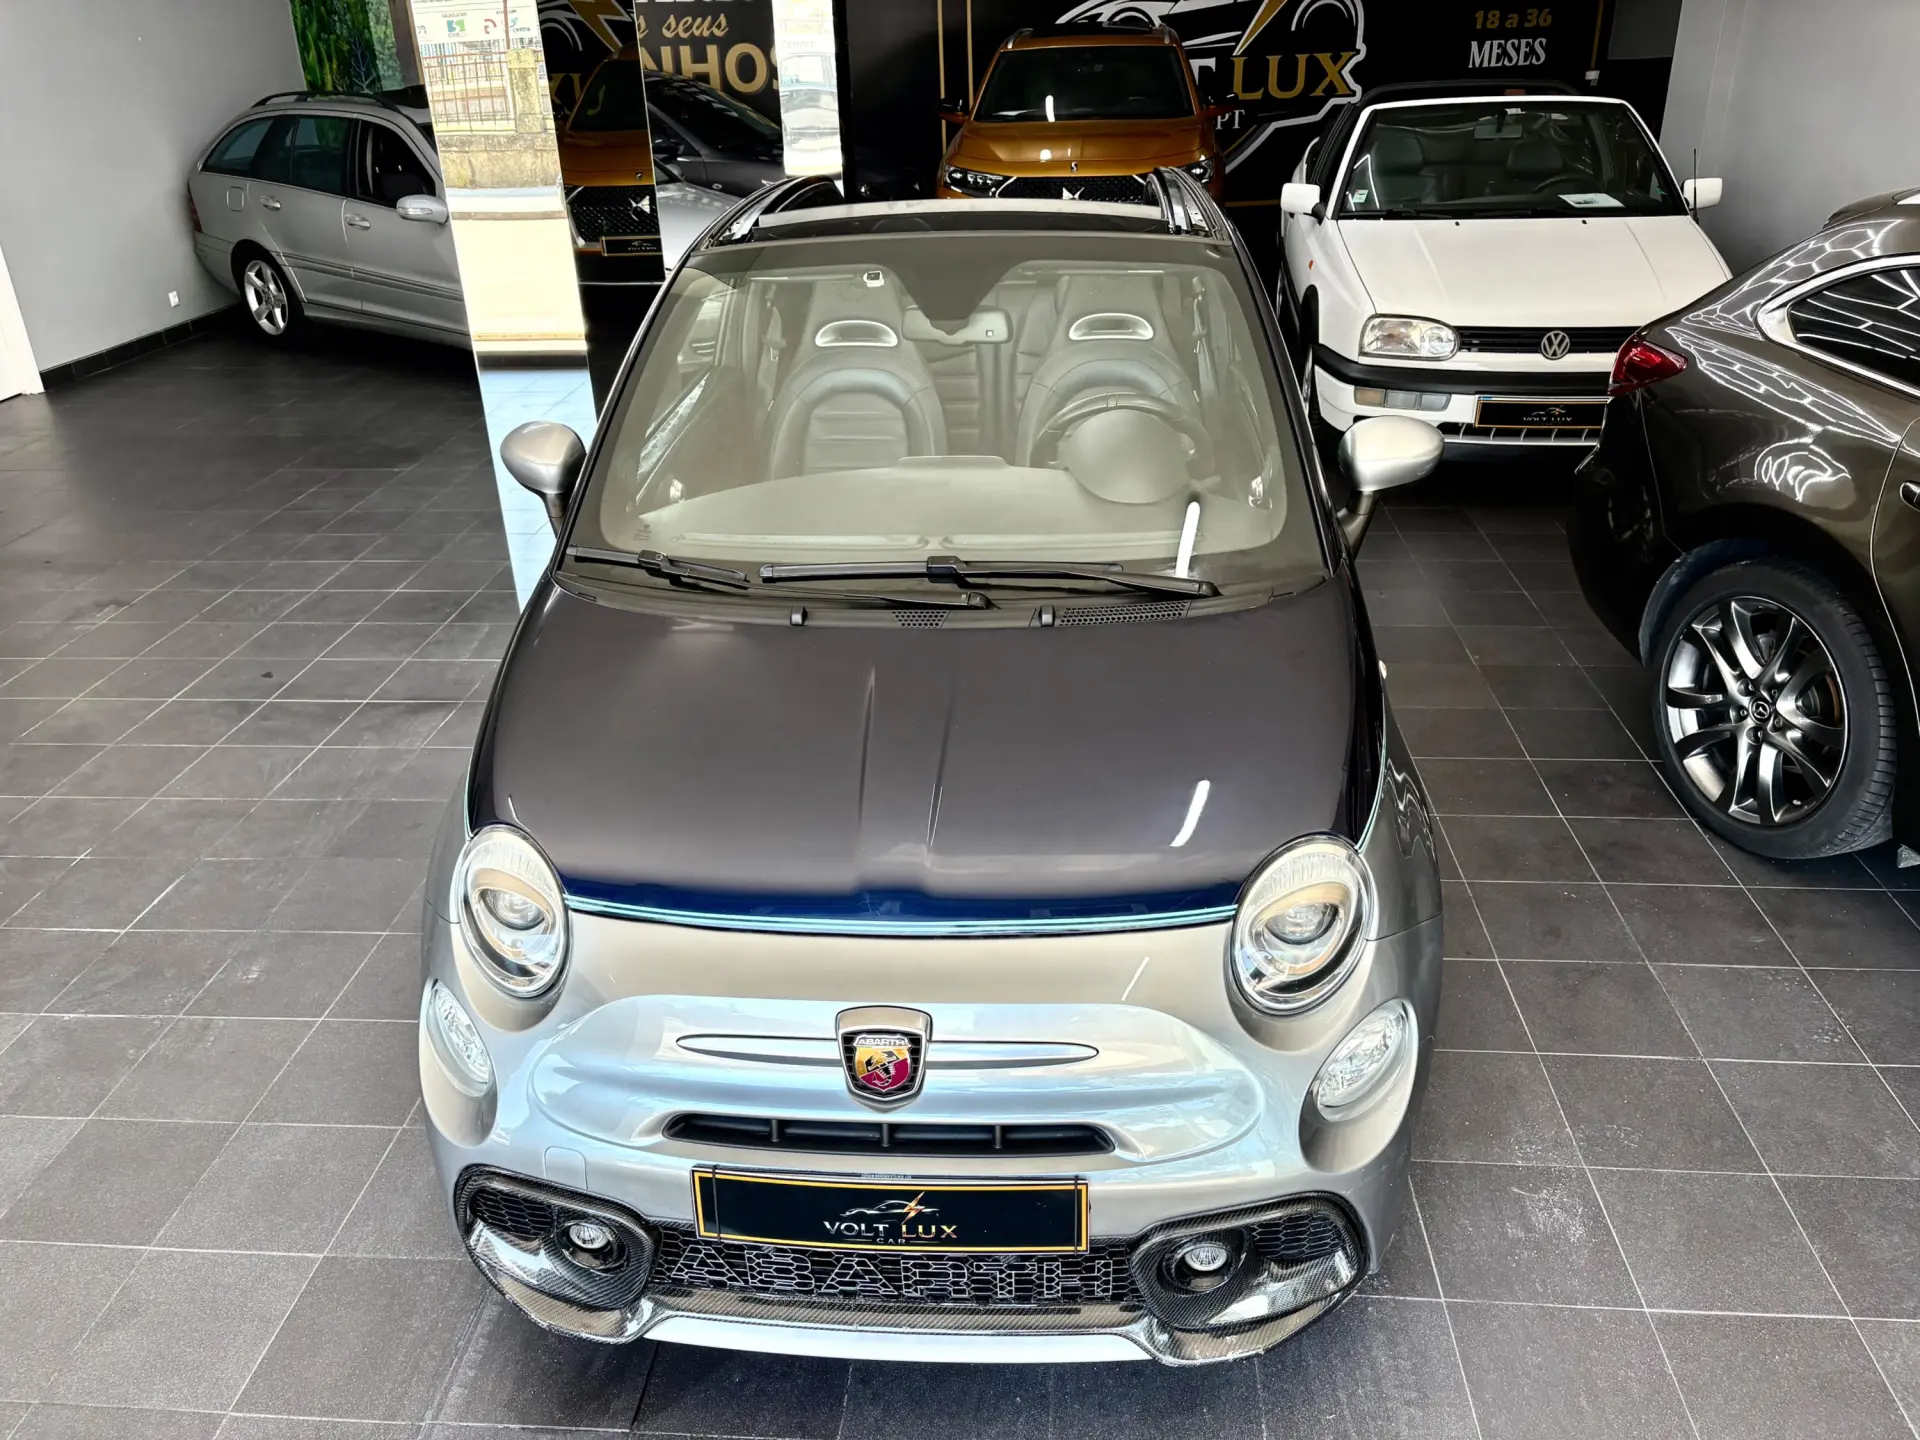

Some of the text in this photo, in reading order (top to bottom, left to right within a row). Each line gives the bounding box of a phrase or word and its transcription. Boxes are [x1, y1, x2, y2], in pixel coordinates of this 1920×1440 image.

[662, 12, 729, 39] seus
[1475, 8, 1552, 29] 18 a 36
[1468, 38, 1547, 68] MESES
[1231, 51, 1357, 100] LUX
[858, 1038, 905, 1046] ABARTH
[823, 1221, 958, 1239] VOLT LUX
[876, 1237, 906, 1245] CAR
[670, 1245, 1113, 1297] ABARTH
